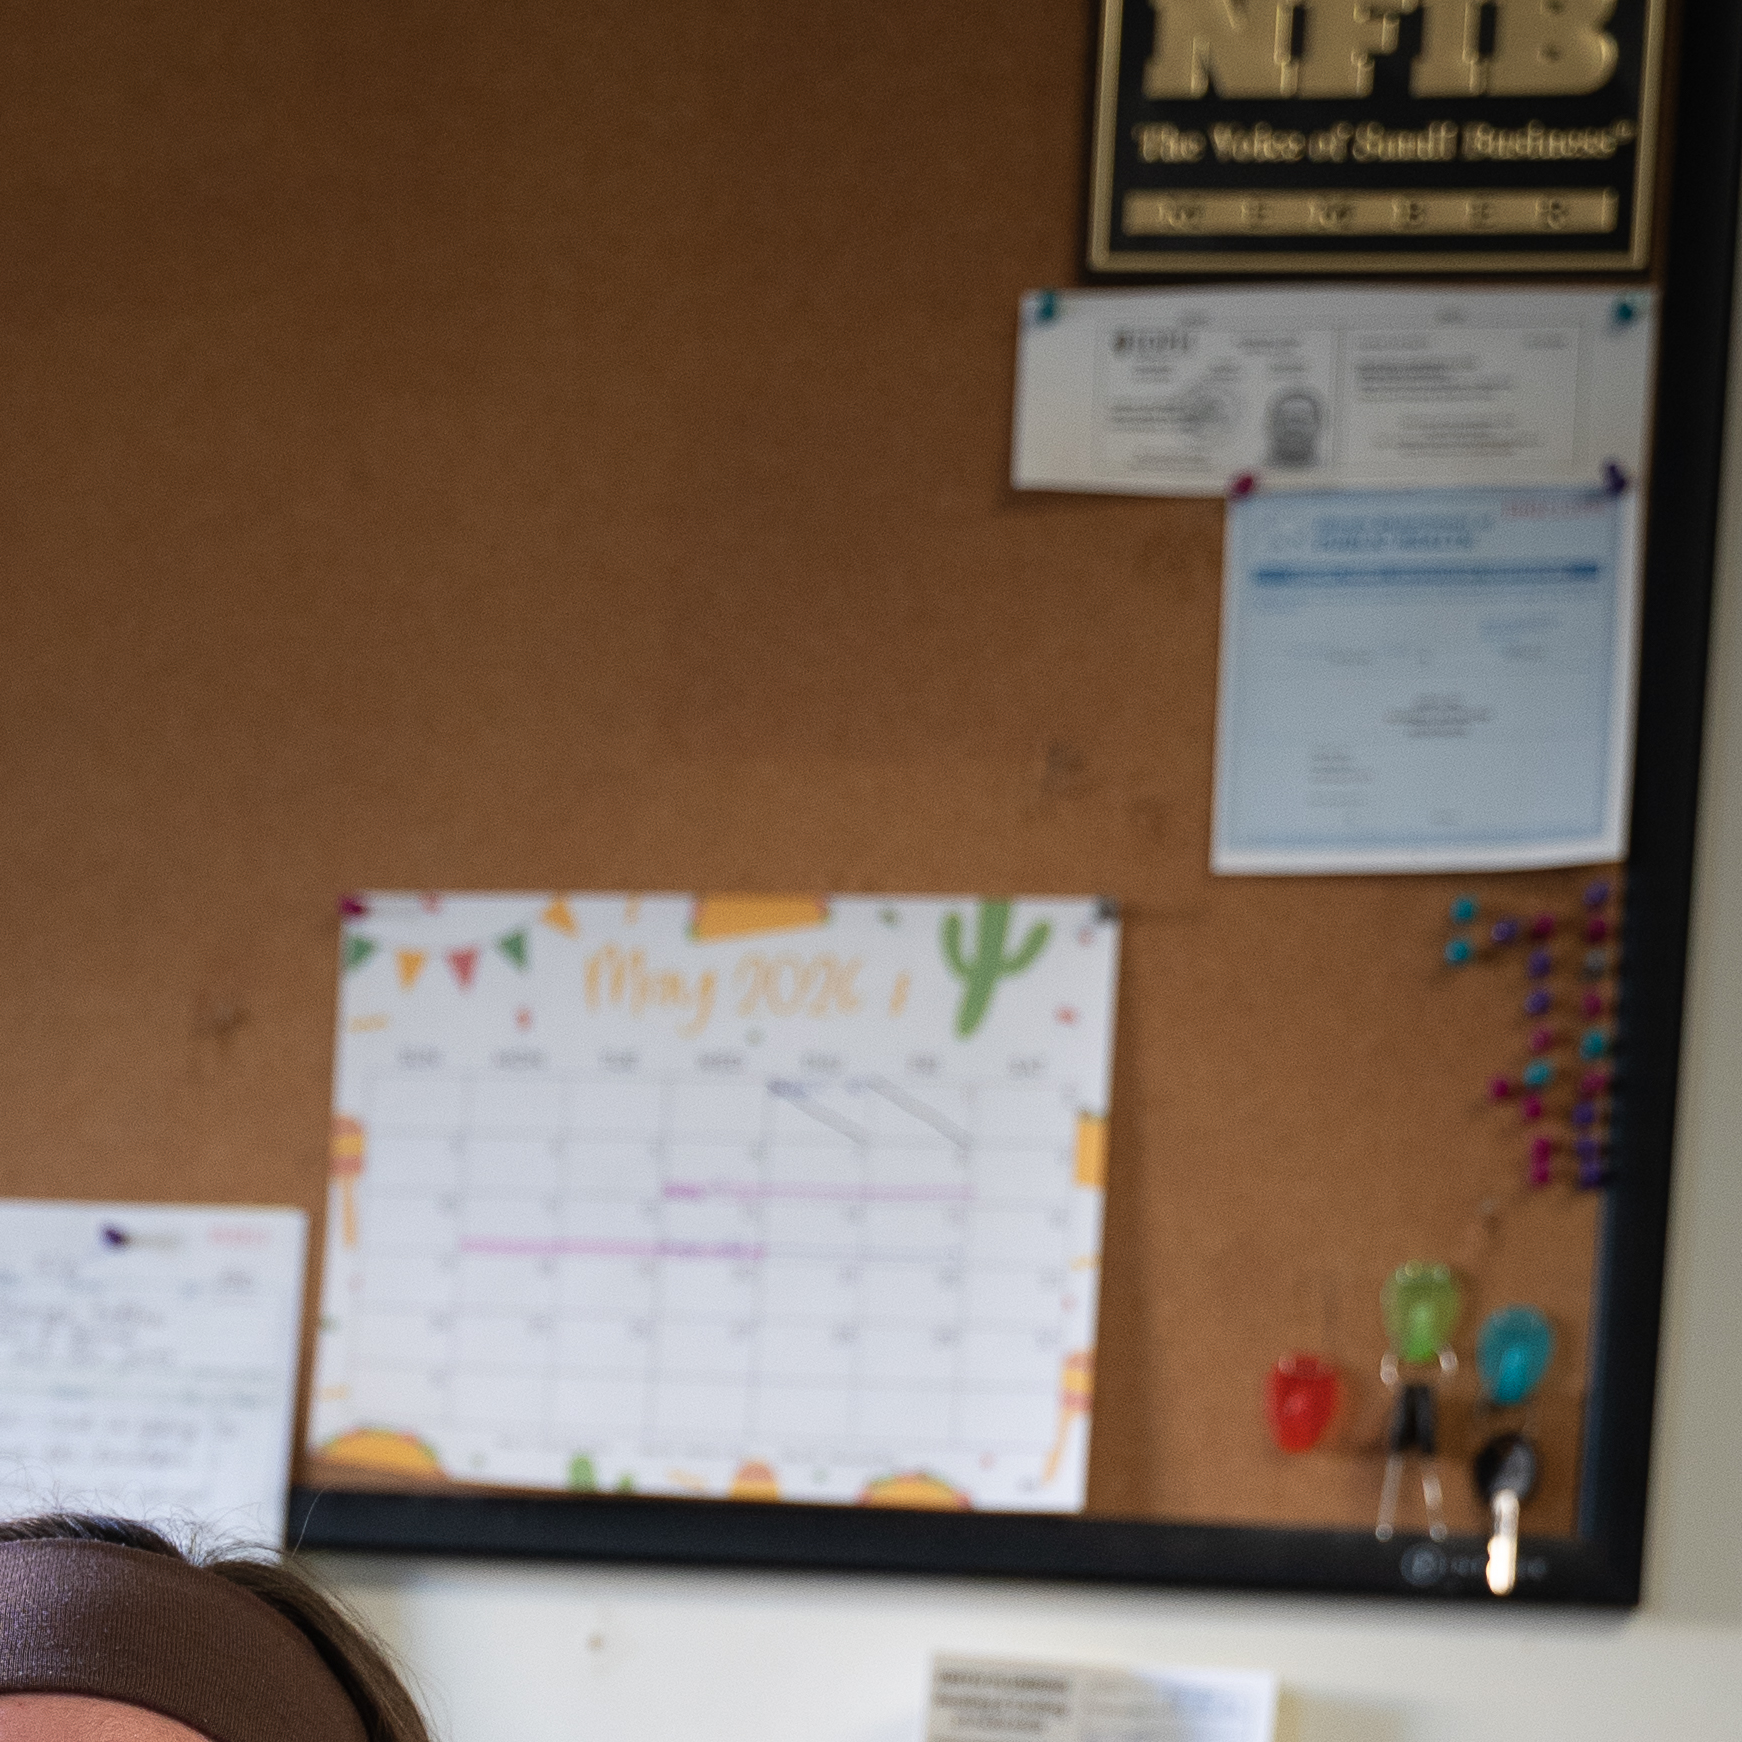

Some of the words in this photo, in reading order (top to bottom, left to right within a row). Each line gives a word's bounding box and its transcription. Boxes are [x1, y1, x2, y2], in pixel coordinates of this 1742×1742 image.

[1142, 0, 1619, 98] NFIB
[1133, 121, 1205, 163] The
[1209, 121, 1305, 163] Voice
[1309, 121, 1353, 162] of
[1354, 121, 1457, 162] Small
[583, 940, 718, 1041] May
[733, 951, 863, 1020] 2026
